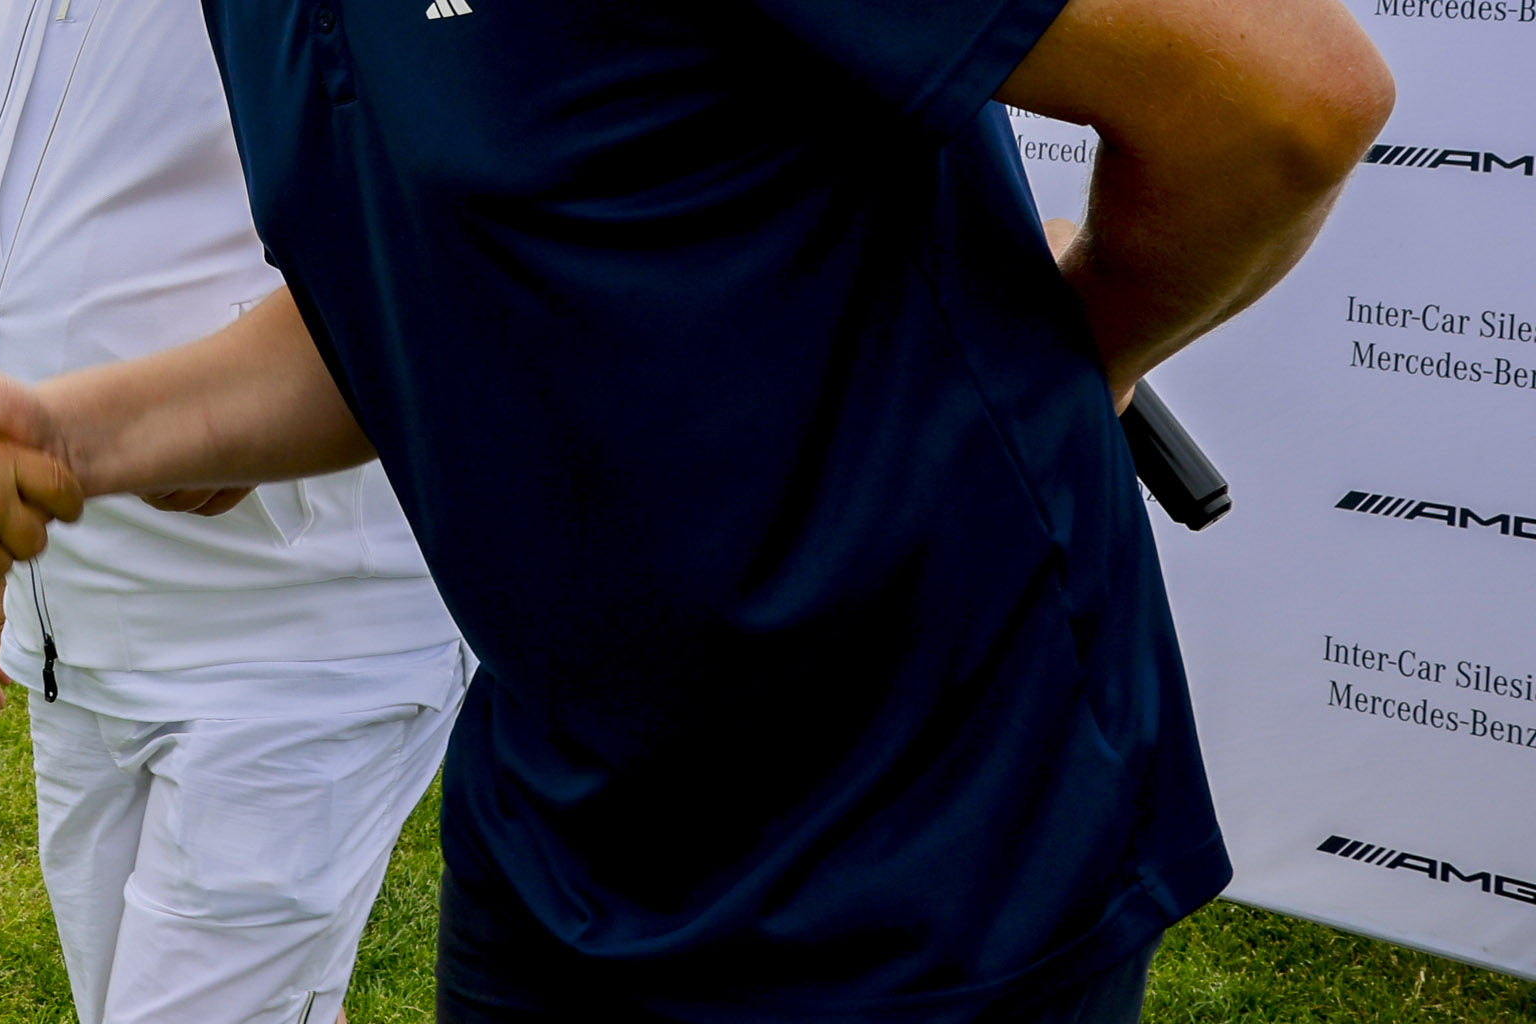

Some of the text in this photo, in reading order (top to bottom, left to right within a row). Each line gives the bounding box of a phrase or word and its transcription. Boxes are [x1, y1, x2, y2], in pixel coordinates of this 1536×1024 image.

[1426, 148, 1536, 177] AM
[1345, 295, 1471, 336] Inter-Car
[1322, 634, 1536, 702] Inter-Car Silesi
